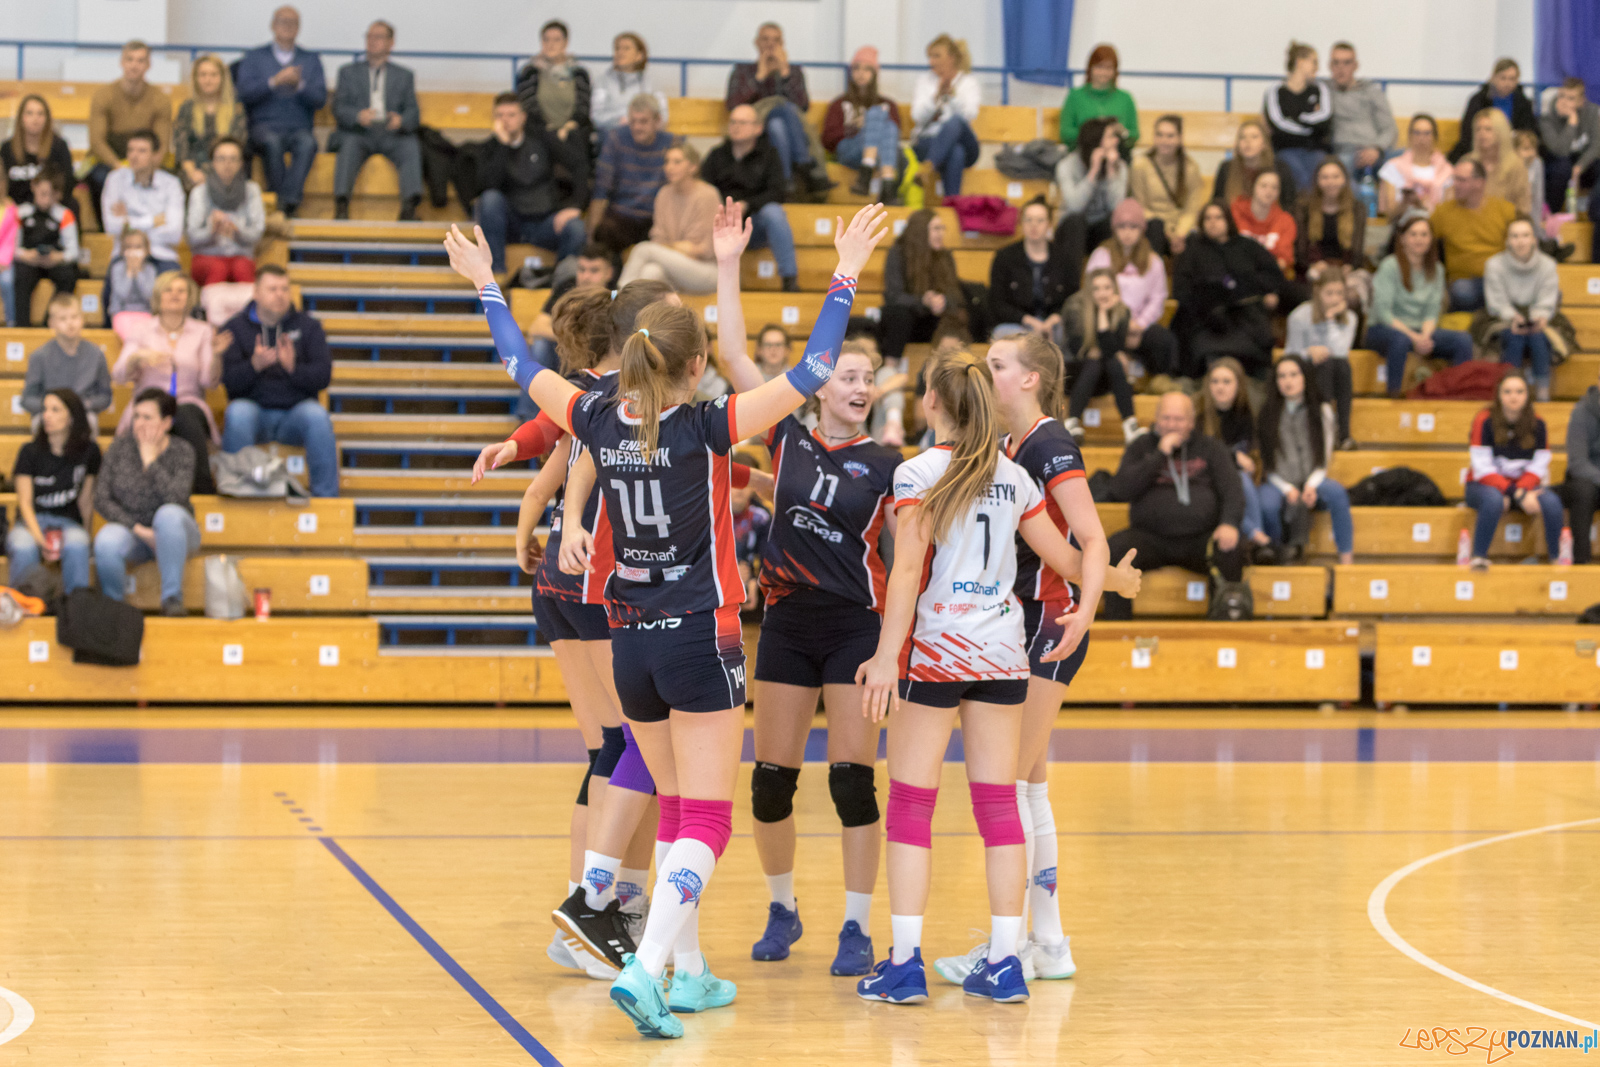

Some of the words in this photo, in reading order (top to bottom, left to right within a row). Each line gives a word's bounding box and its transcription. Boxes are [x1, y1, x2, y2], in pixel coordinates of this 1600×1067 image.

[610, 478, 671, 538] 14
[793, 513, 843, 543] Enea
[730, 665, 745, 689] 14
